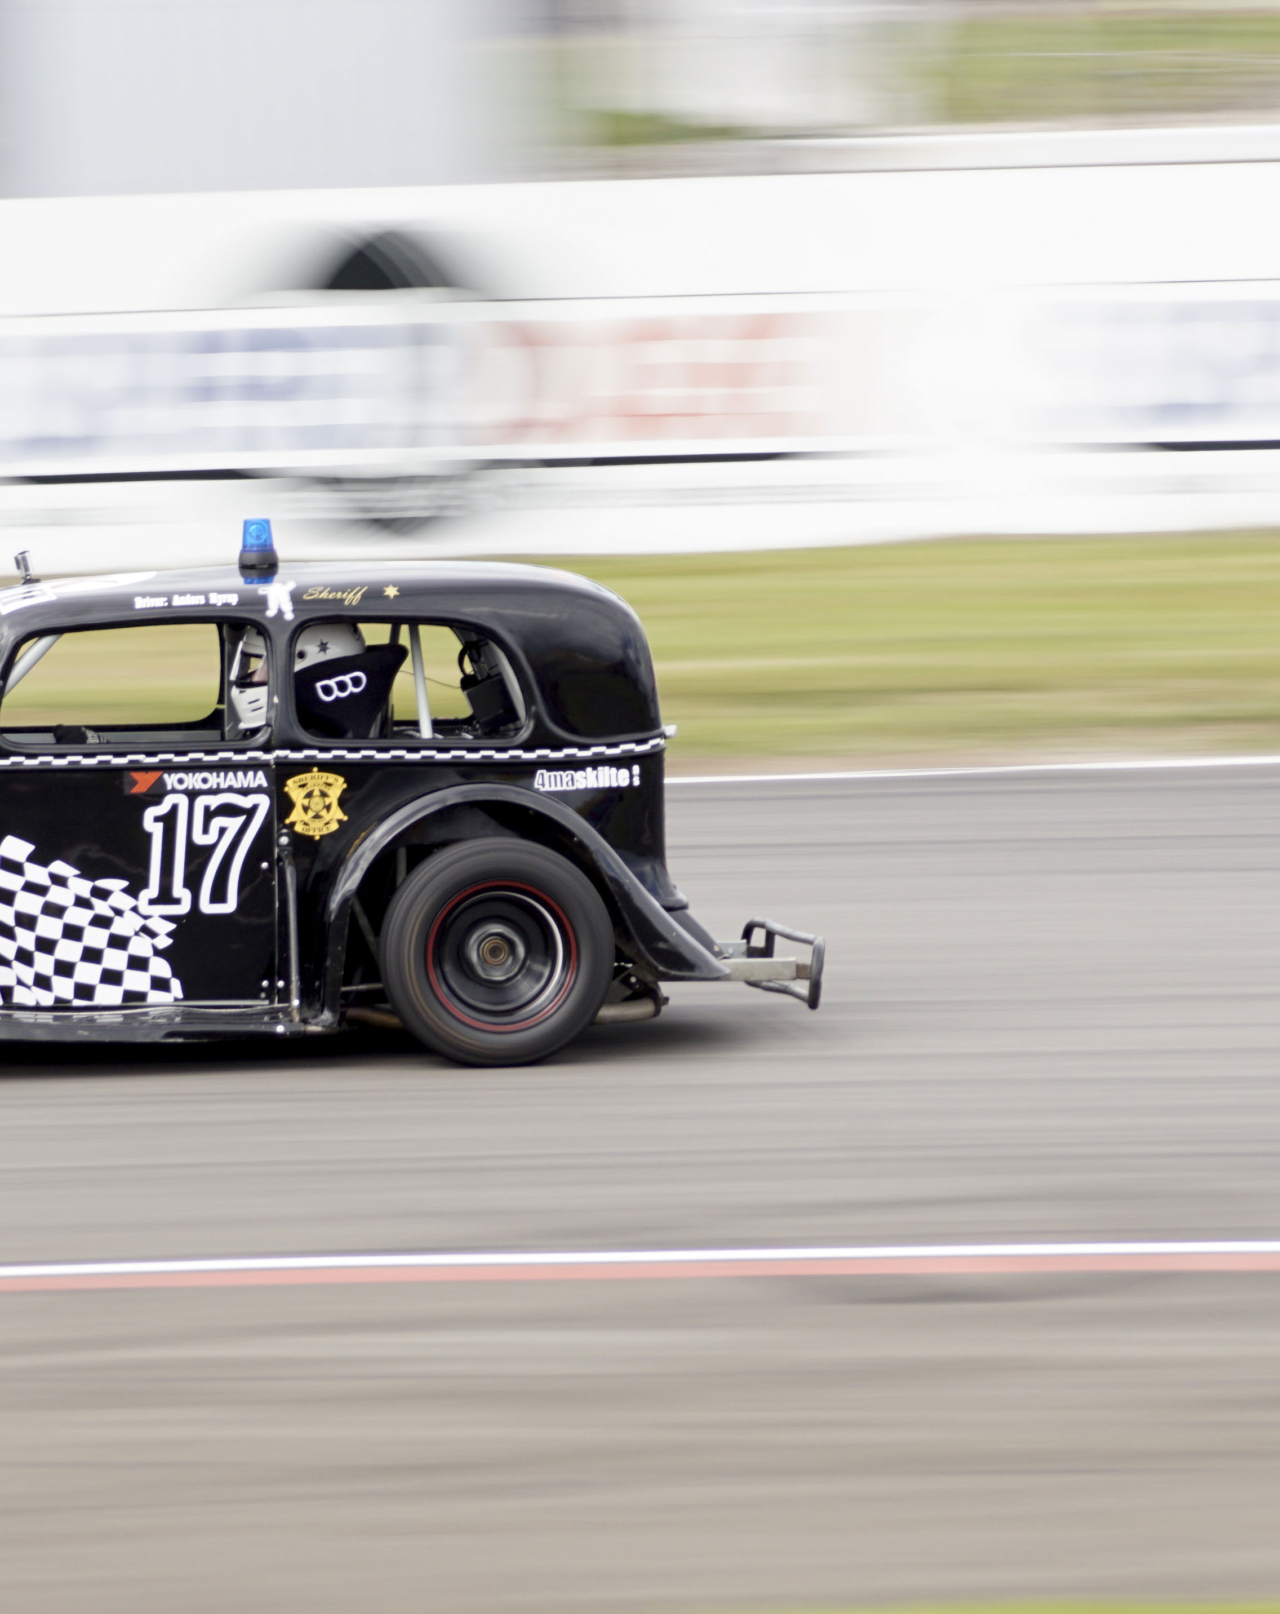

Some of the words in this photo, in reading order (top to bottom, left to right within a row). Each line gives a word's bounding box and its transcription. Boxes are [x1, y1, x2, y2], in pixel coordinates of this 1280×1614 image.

[303, 586, 369, 606] Sheriff
[163, 771, 268, 790] YOKOHAMA
[534, 766, 630, 792] 4maskilte
[137, 792, 271, 916] 17
